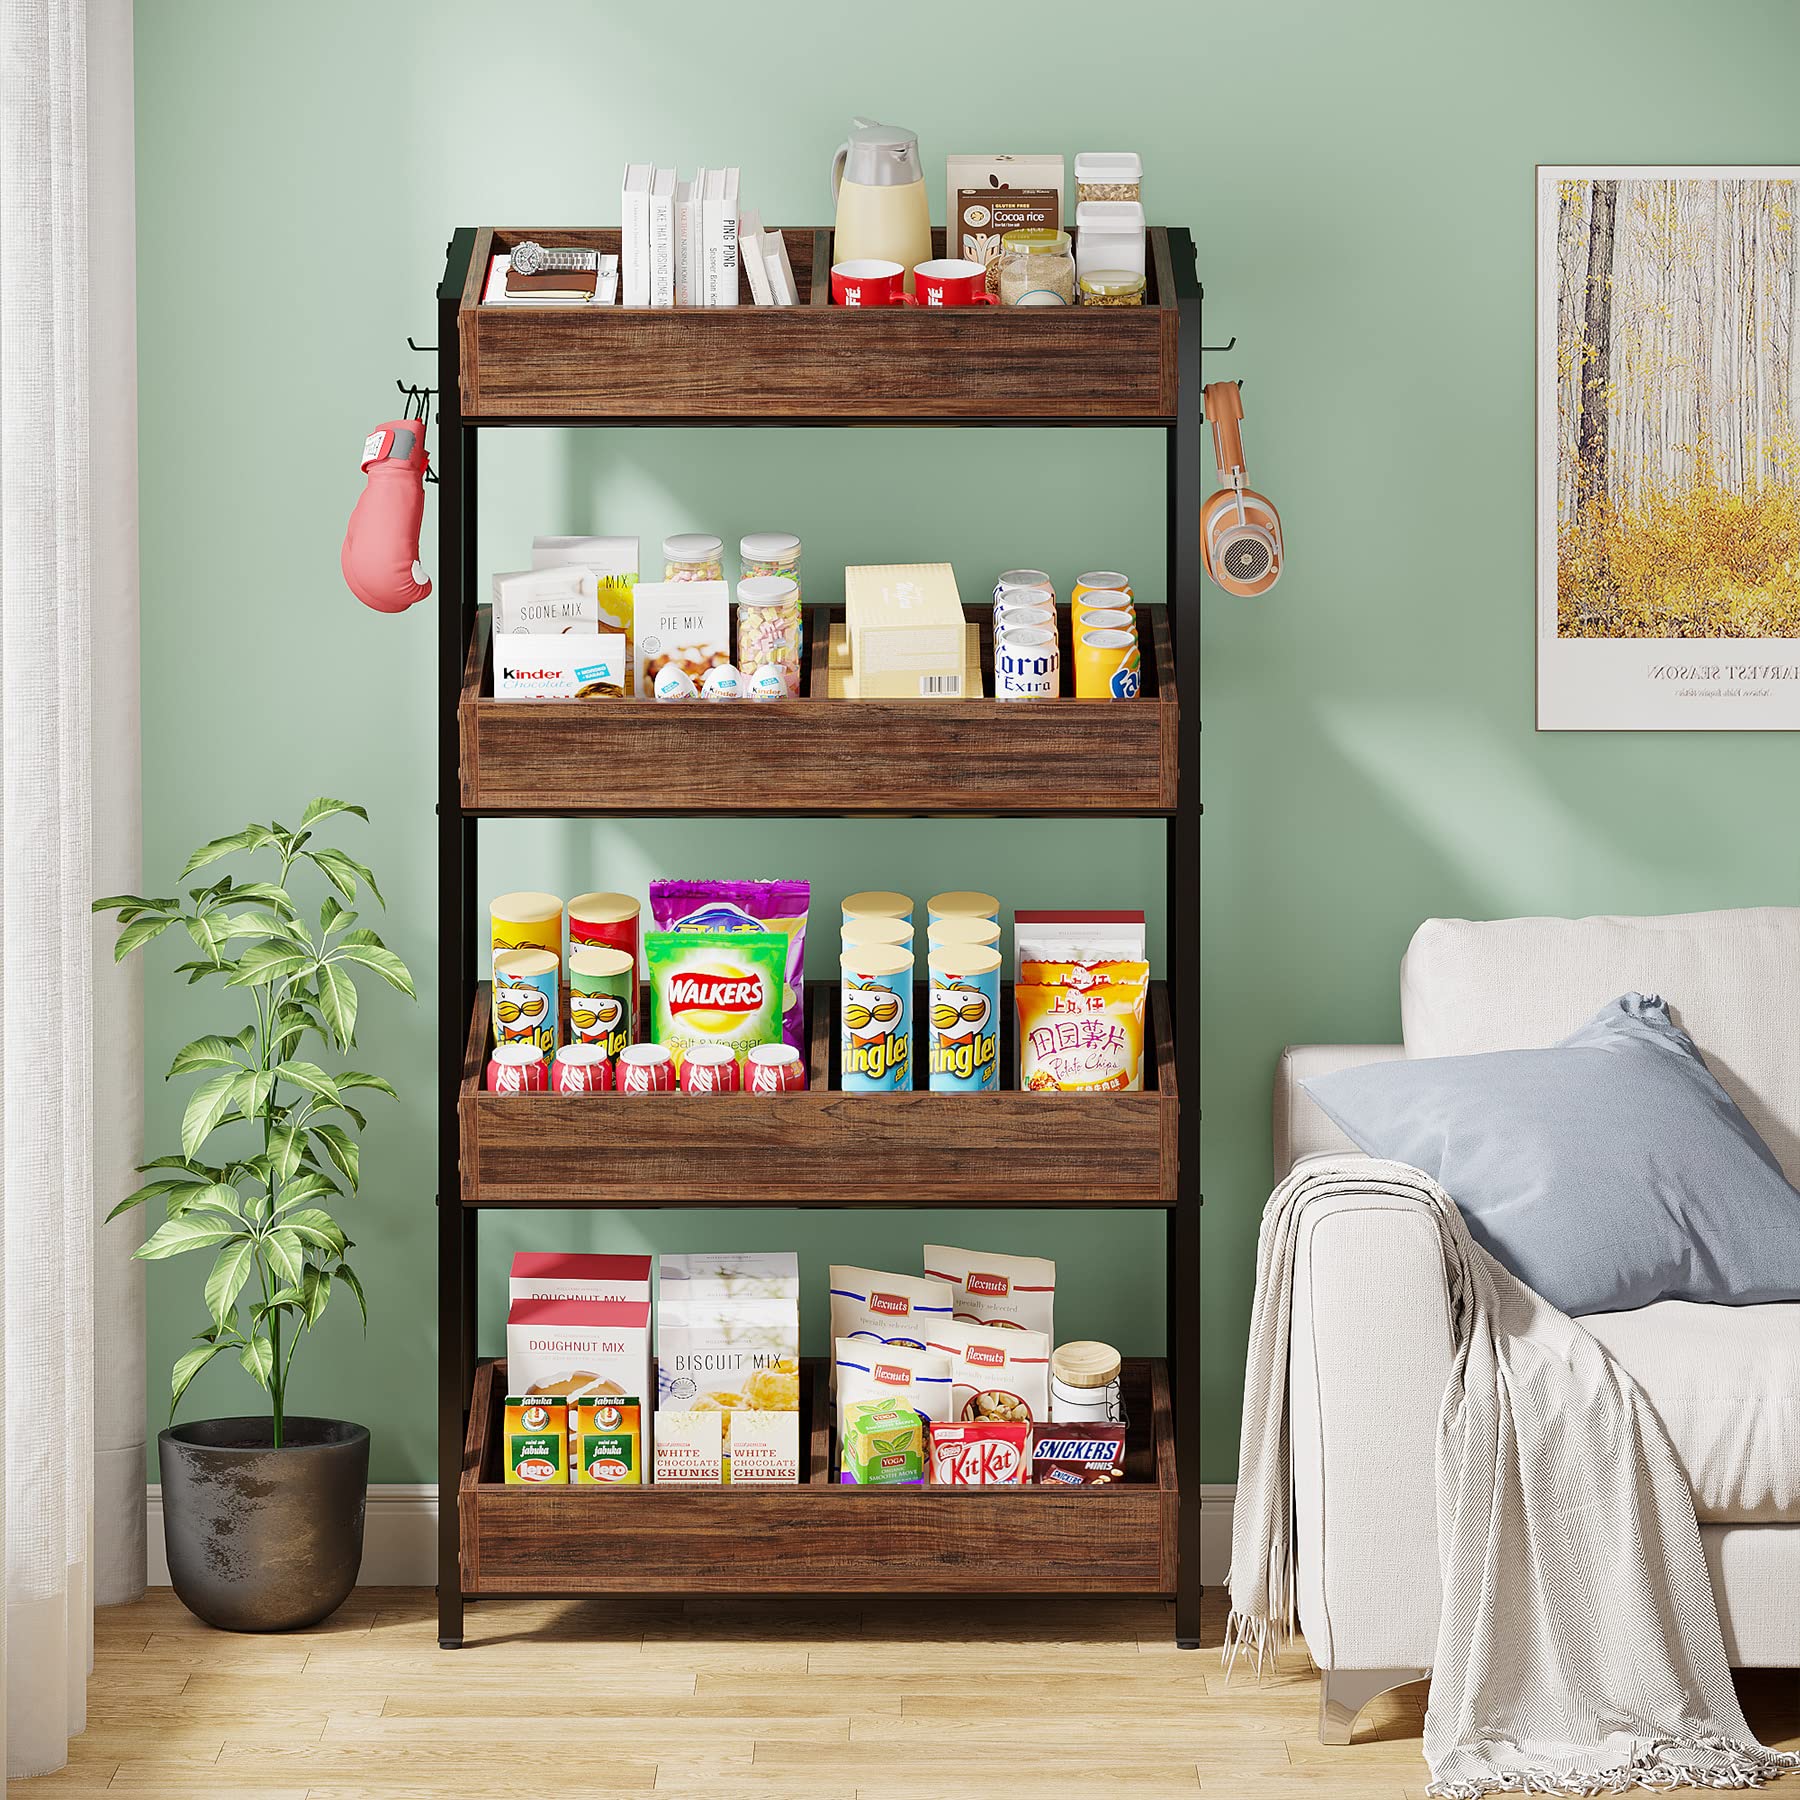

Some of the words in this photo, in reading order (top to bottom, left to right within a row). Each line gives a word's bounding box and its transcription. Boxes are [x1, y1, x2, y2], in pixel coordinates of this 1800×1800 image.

[656, 204, 667, 222] TAKE
[994, 211, 1025, 222] Cocoa
[1026, 211, 1045, 222] rice
[656, 224, 667, 242] THAT
[723, 219, 736, 241] PING
[656, 243, 667, 275] NURSING
[680, 238, 688, 266] NURSING
[723, 244, 736, 268] PONG
[680, 266, 688, 284] HOME
[709, 274, 718, 292] Brian
[656, 276, 667, 296] HOME
[605, 575, 628, 589] MIX
[520, 604, 557, 621] SCONE
[562, 602, 582, 617] MIX
[660, 616, 678, 630] PIE
[684, 616, 704, 630] MIX
[503, 680, 574, 690] Chocolate
[1004, 677, 1051, 692] Extra
[1110, 668, 1141, 698] Fa
[669, 978, 763, 1006] WALKERS
[670, 1036, 695, 1049] Salt
[1048, 1057, 1083, 1081] Potato
[1084, 1053, 1119, 1076] Chips
[967, 1274, 1007, 1292] flexnuts
[870, 1294, 908, 1311] flexnuts
[529, 1340, 598, 1352] DOUGHNUT
[602, 1342, 625, 1353] MIX
[966, 1346, 1004, 1363] flexnuts
[675, 1354, 743, 1371] BISCUIT
[753, 1353, 782, 1369] MIX
[874, 1366, 910, 1382] flexnuts
[657, 1449, 700, 1457] WHITE
[734, 1449, 777, 1457] WHITE
[1034, 1440, 1117, 1460] SNICKERS
[657, 1459, 719, 1467] CHOCOLATE
[733, 1459, 796, 1467] CHOCOLATE
[951, 1444, 1012, 1484] KitKat
[1085, 1461, 1114, 1471] MINIS
[657, 1468, 719, 1477] CHUNKS
[734, 1468, 796, 1477] CHUNKS
